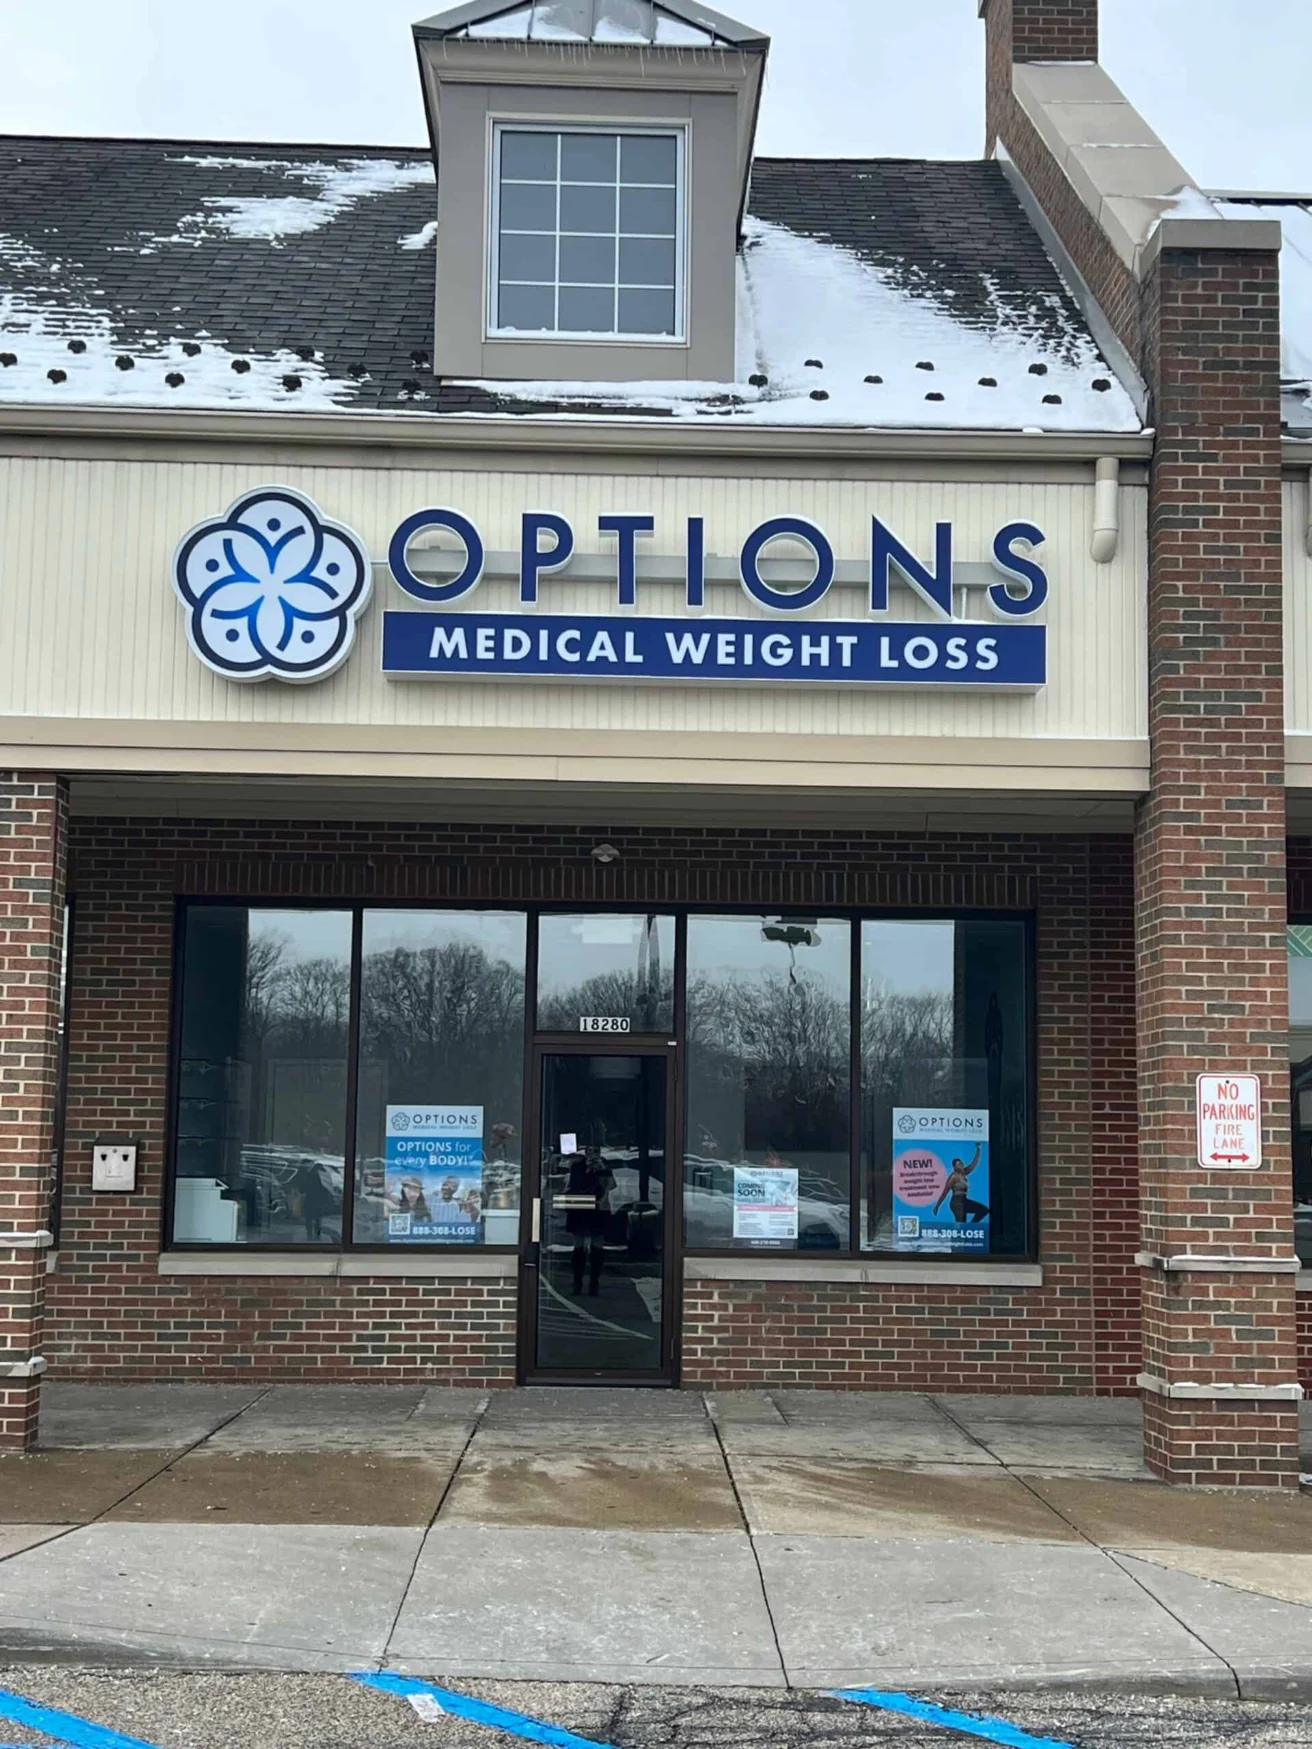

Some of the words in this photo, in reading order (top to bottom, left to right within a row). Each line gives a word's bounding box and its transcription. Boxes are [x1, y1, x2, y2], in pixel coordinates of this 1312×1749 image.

[387, 507, 1049, 618] OPTIONS
[429, 626, 644, 663] MEDICAL
[665, 631, 858, 667] WEIGHT
[879, 636, 999, 671] LOSS
[582, 1018, 629, 1031] 18280
[1217, 1083, 1239, 1101] NO
[1202, 1103, 1255, 1121] PARKING
[412, 1114, 478, 1125] OPTIONS
[918, 1116, 984, 1128] OPTIONS
[1215, 1123, 1243, 1136] FIRE
[396, 1141, 452, 1152] OPTIONS
[455, 1141, 472, 1153] for
[1213, 1137, 1245, 1150] LANE
[394, 1155, 427, 1169] every
[903, 1159, 933, 1169] NEW!
[737, 1188, 766, 1198] SOON
[921, 1228, 985, 1239] 888-308-LOSE
